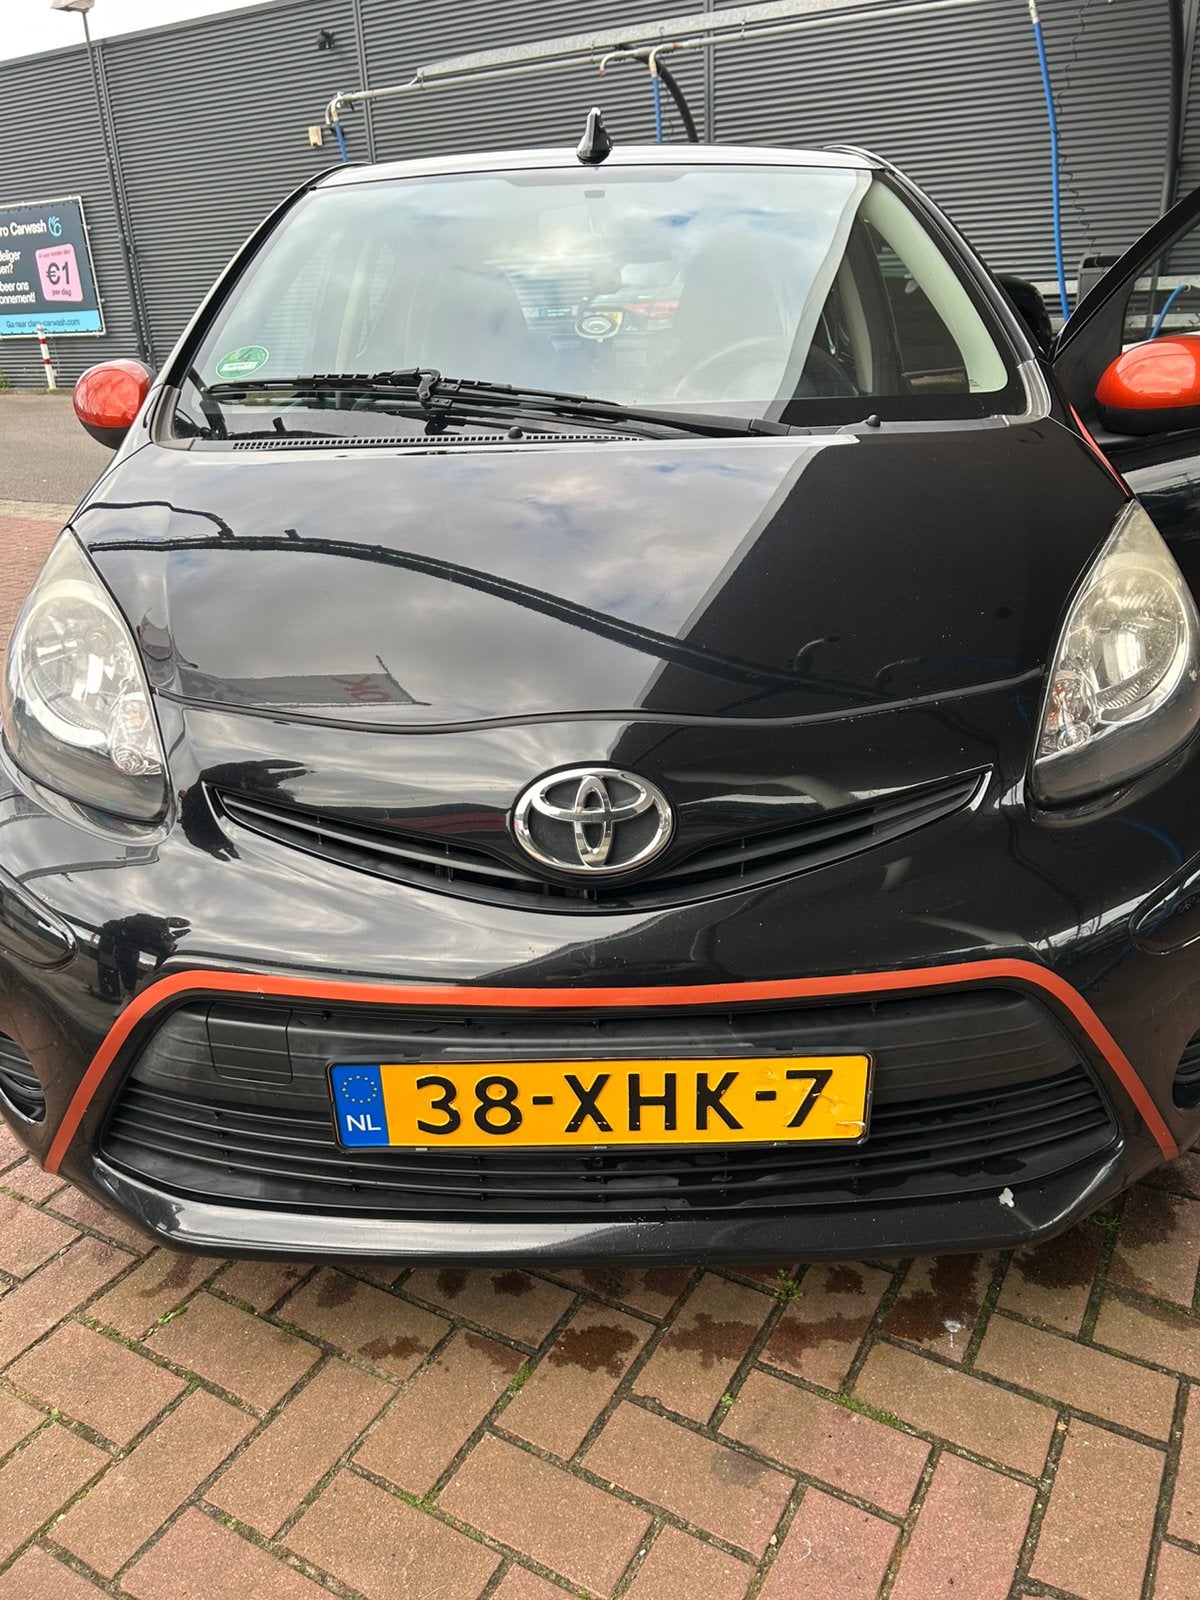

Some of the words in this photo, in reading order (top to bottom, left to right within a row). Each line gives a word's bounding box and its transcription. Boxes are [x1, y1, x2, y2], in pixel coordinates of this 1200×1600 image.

[10, 219, 47, 236] Carwash
[46, 262, 70, 285] €1
[16, 282, 30, 291] ons
[61, 288, 72, 297] dag
[6, 320, 15, 328] Ga
[415, 1069, 834, 1135] 38-XHK-7
[346, 1114, 382, 1132] NL
